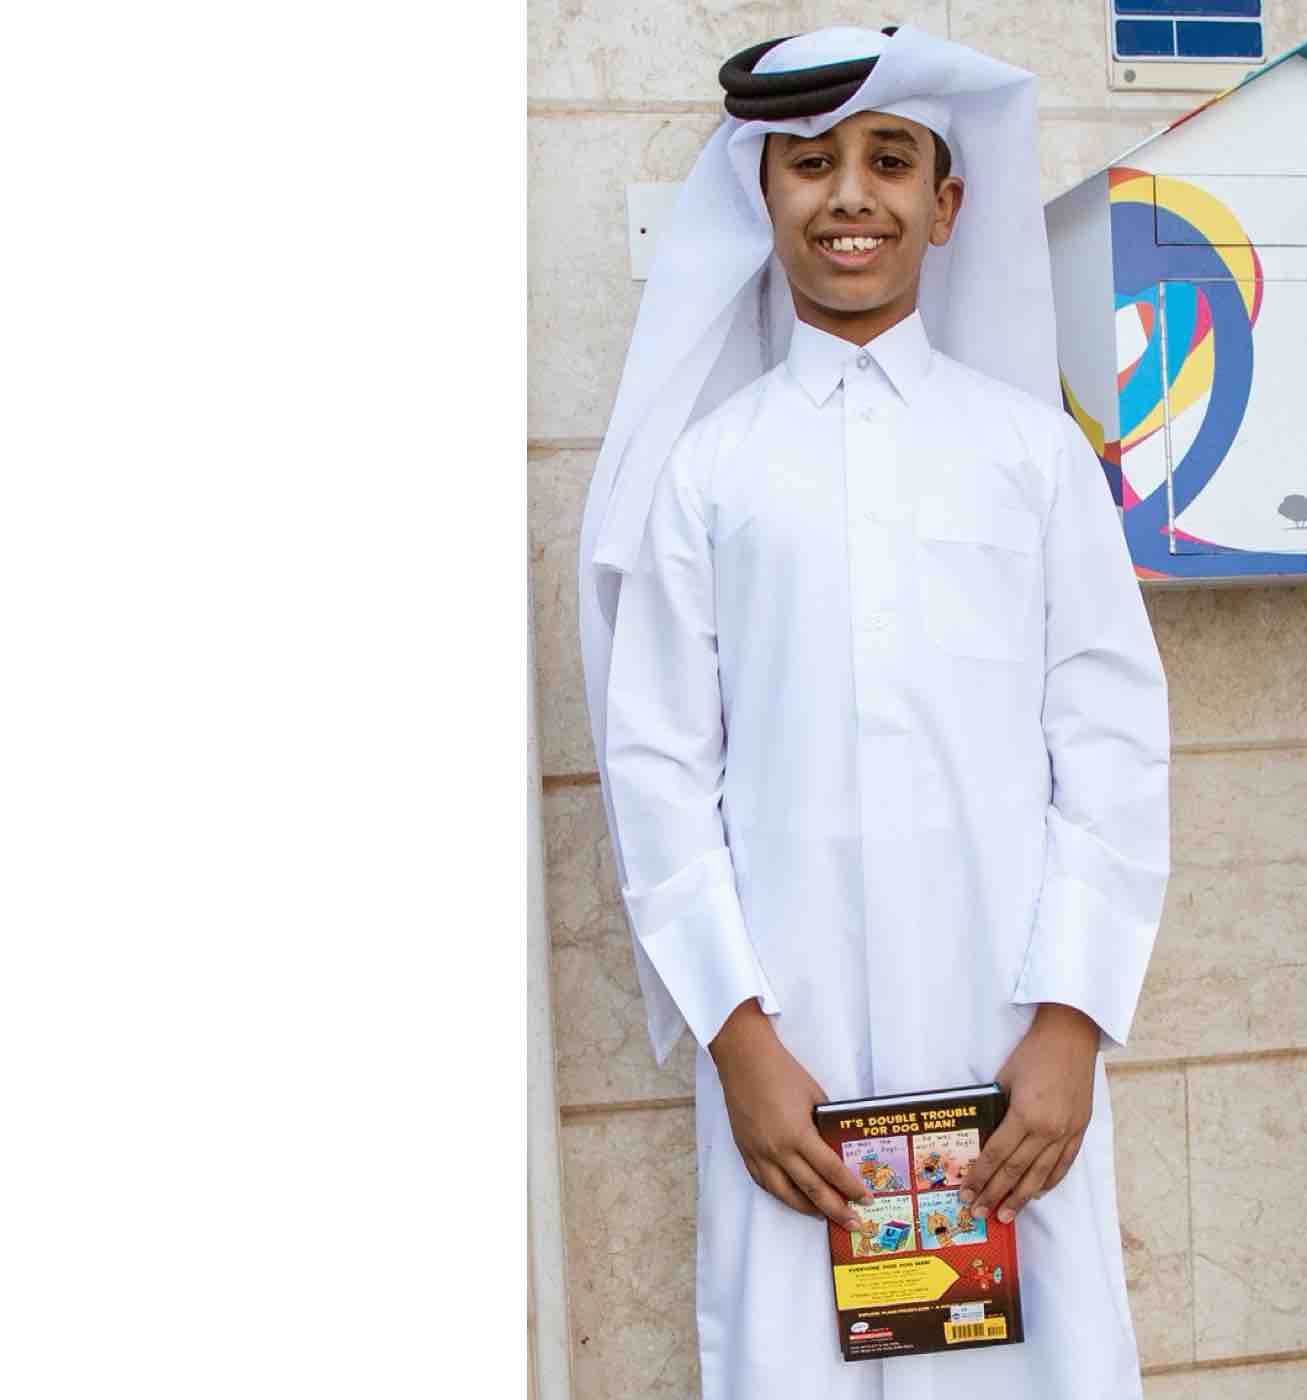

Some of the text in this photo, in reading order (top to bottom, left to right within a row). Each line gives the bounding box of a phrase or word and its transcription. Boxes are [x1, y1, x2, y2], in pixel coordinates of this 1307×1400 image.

[840, 1106, 977, 1129] IT'S DOUBLE TROUBLE
[863, 1118, 957, 1137] FOR DOG MAN!
